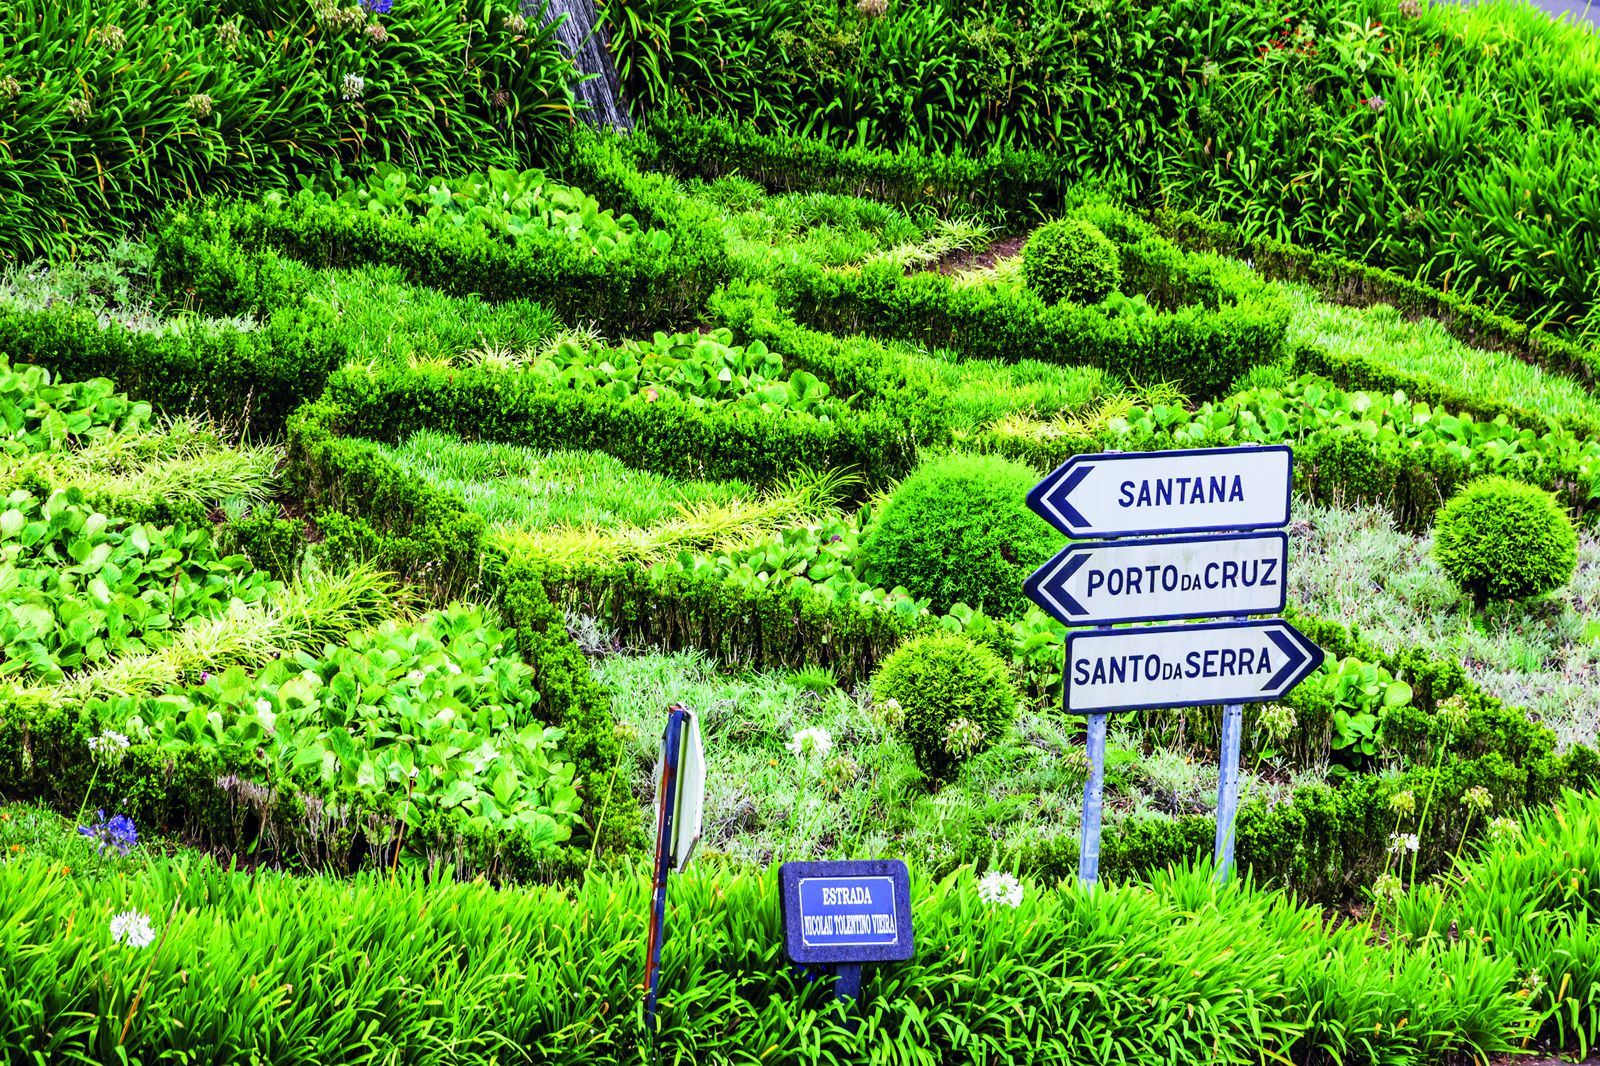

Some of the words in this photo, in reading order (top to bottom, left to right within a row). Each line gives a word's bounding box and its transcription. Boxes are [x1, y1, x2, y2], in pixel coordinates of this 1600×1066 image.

[1118, 474, 1244, 508] SANTANA
[1087, 564, 1179, 598] PORTO
[1204, 558, 1278, 590] CRUZ
[1073, 653, 1161, 686] SANTO
[1184, 646, 1272, 679] SERRA
[822, 887, 873, 905] ESTRADA
[803, 915, 834, 936] NICOLAU
[834, 914, 871, 935] TOLENTINO
[871, 914, 896, 934] VIEIRA
